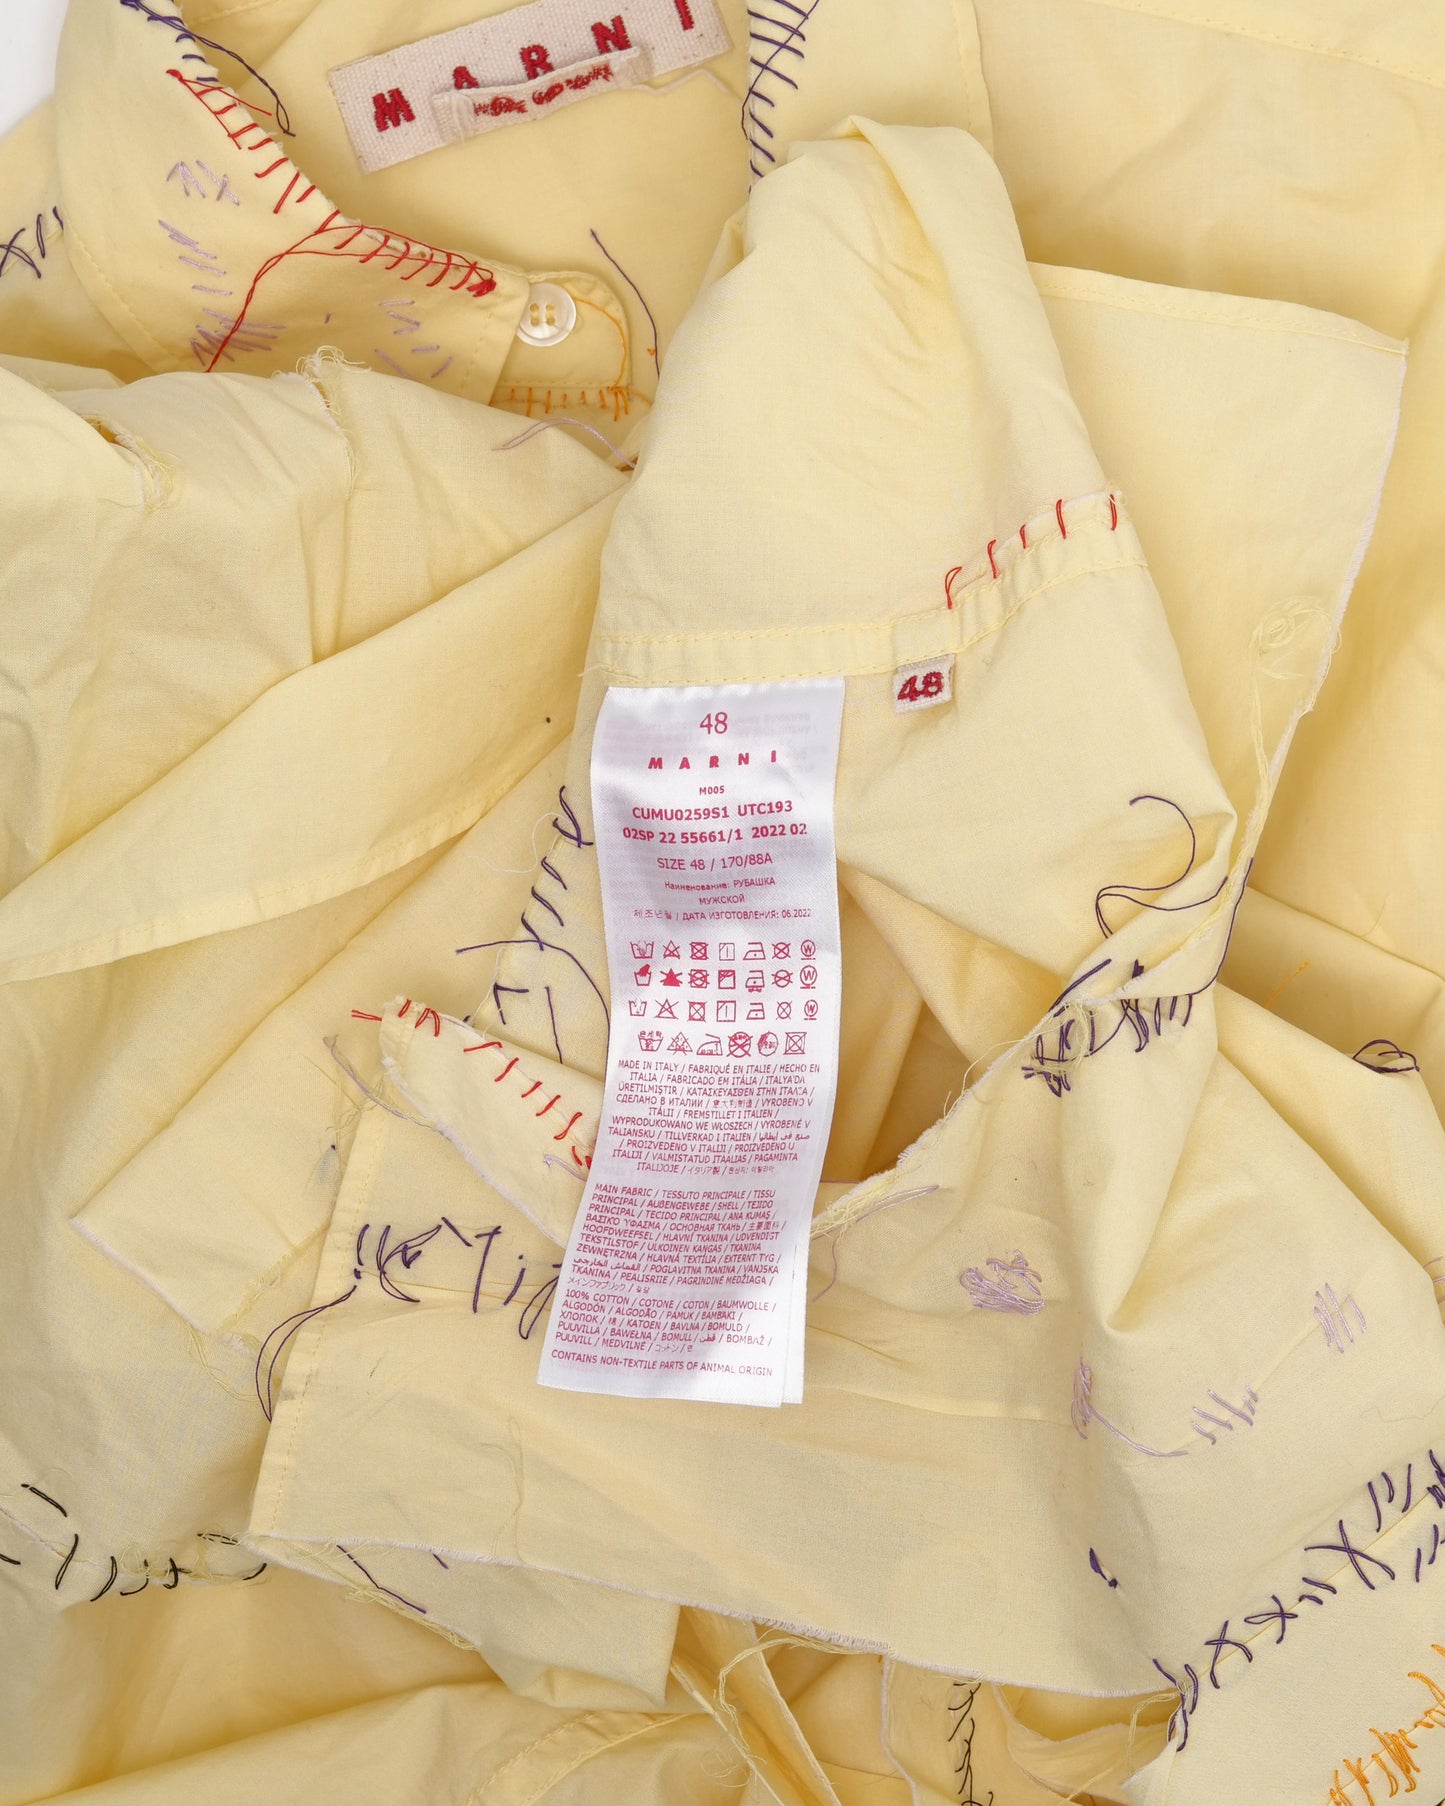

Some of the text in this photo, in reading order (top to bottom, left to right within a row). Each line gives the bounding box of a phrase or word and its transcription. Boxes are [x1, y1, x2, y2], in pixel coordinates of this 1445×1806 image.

[371, 0, 695, 132] MARNI
[897, 671, 945, 700] 48
[700, 711, 728, 735] 48
[648, 750, 777, 770] MARNI
[699, 786, 725, 796] M005
[632, 800, 792, 821] CUMU0259S1 UTC193
[622, 827, 654, 841] 02SP
[659, 832, 676, 844] 22
[680, 828, 742, 844] 55661/1
[751, 824, 787, 839] 2022
[657, 852, 773, 871] SIZE 48 170/88A
[733, 877, 775, 888] РУБАШКА
[699, 893, 745, 905] МУЖСКОЙ
[682, 912, 706, 921] ДАТА
[618, 1059, 820, 1075] MADE IN ITALY FABRIQUÉ EN ITALIE HECHO EN
[630, 1072, 657, 1082] ITALIA
[667, 1074, 715, 1086] FABRICADO
[718, 1076, 729, 1086] EM
[732, 1074, 757, 1086] ITÁLIA
[616, 1093, 657, 1105] СДЕЛАНО
[669, 1097, 703, 1108] ИТАЛИИ
[807, 1098, 813, 1107] V
[684, 1109, 736, 1119] FREMSTILLET
[743, 1109, 772, 1118] ITALIEN
[612, 1116, 693, 1130] WYPRODUKOWANO
[696, 1122, 708, 1131] WE
[805, 1120, 811, 1129] V
[608, 1126, 655, 1138] TALIANSKU
[665, 1130, 714, 1142] TILLVERKAD
[723, 1133, 751, 1141] ITALIEN
[626, 1139, 687, 1151] PROIZVEDENO
[690, 1144, 696, 1152] V
[734, 1142, 786, 1152] PROIZVEDENO
[788, 1142, 795, 1150] U
[652, 1152, 710, 1164] VALMISTATUD
[712, 1154, 747, 1164] ITAALIAS
[754, 1153, 798, 1162] PAGAMINTA
[595, 1184, 776, 1200] MAIN FABRIC TESSUTO PRINCIPALE TISSU
[592, 1193, 638, 1206] PRINCIPAL
[717, 1201, 738, 1211] SHELL
[747, 1200, 773, 1209] TEJIDO
[589, 1203, 635, 1217] PRINCIPAL
[645, 1210, 677, 1220] TECIDO
[680, 1212, 721, 1221] PRINCIPAL
[728, 1211, 743, 1220] ANA
[583, 1223, 653, 1240] HOOFDWEEFSEL
[696, 1234, 728, 1242] TKANINA
[736, 1232, 780, 1241] UDVENDIGT
[669, 1222, 715, 1231] ОСНОВНАЯ
[580, 1232, 761, 1253] TEKSTILSTOF ULKOINEN KANGAS TKANINA
[724, 1254, 757, 1263] EXTERNT
[759, 1254, 775, 1262] TYG
[572, 1264, 611, 1278] TKANINA
[621, 1272, 668, 1284] PEALISRIIE
[650, 1264, 701, 1274] POGLAVITNA
[704, 1265, 736, 1274] TKANINA
[744, 1264, 779, 1274] VANJSKA
[565, 1289, 769, 1311] 100% COTTON COTONE COTON BAUMWOLLE
[562, 1300, 605, 1313] ALGODÓN
[666, 1311, 694, 1319] PAMUK
[560, 1310, 598, 1323] ХЛОПОК
[627, 1319, 661, 1330] KATOEN
[670, 1322, 700, 1330] BAVLNA
[707, 1322, 743, 1332] BOMULD
[555, 1331, 592, 1345] PUUVILL
[558, 1320, 600, 1335] PUUVILLA
[661, 1332, 692, 1342] BOMULL
[551, 1349, 773, 1376] CONTAINS NON-TEXTILE PARTS OF ANIMAL ORIGIN
